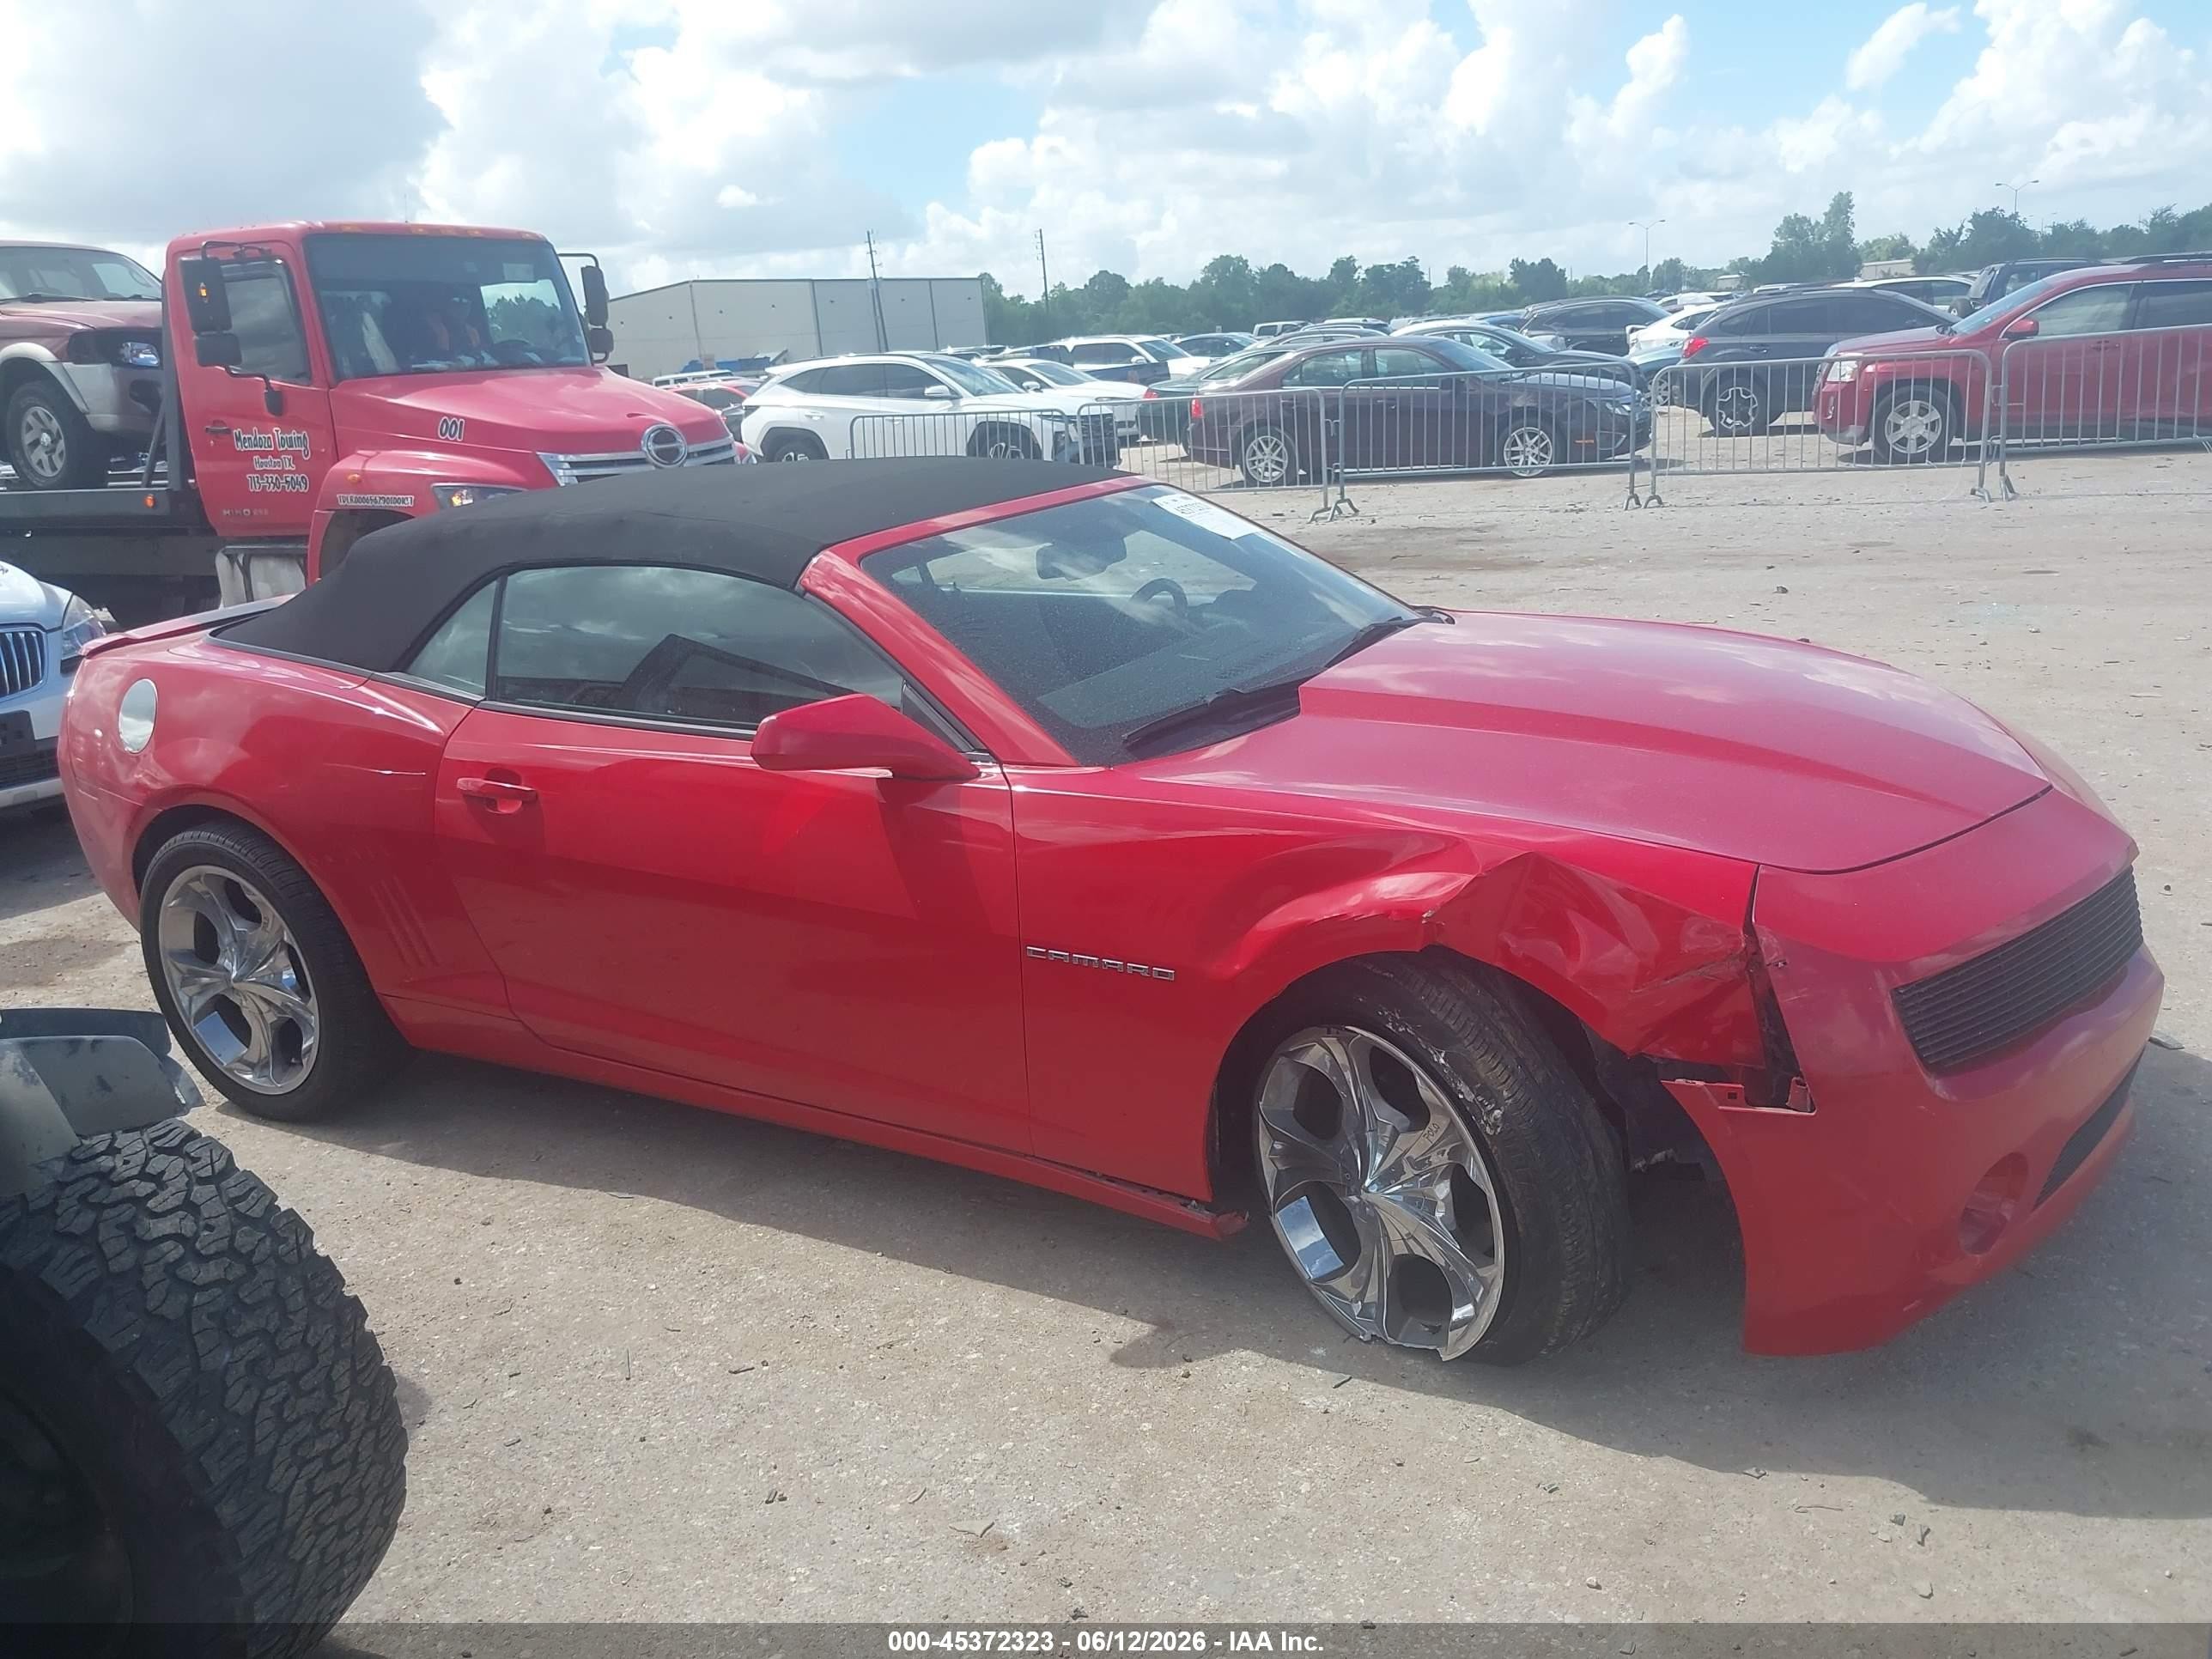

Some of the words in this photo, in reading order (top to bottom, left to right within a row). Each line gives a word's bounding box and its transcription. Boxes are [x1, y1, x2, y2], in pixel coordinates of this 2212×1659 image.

[439, 416, 465, 441] 001
[234, 428, 273, 451] Mendoza
[273, 428, 310, 459] Towing
[254, 456, 282, 470] Houston
[282, 455, 295, 470] TX
[246, 474, 309, 492] 713-330-5049
[1026, 946, 1175, 981] CAMARO
